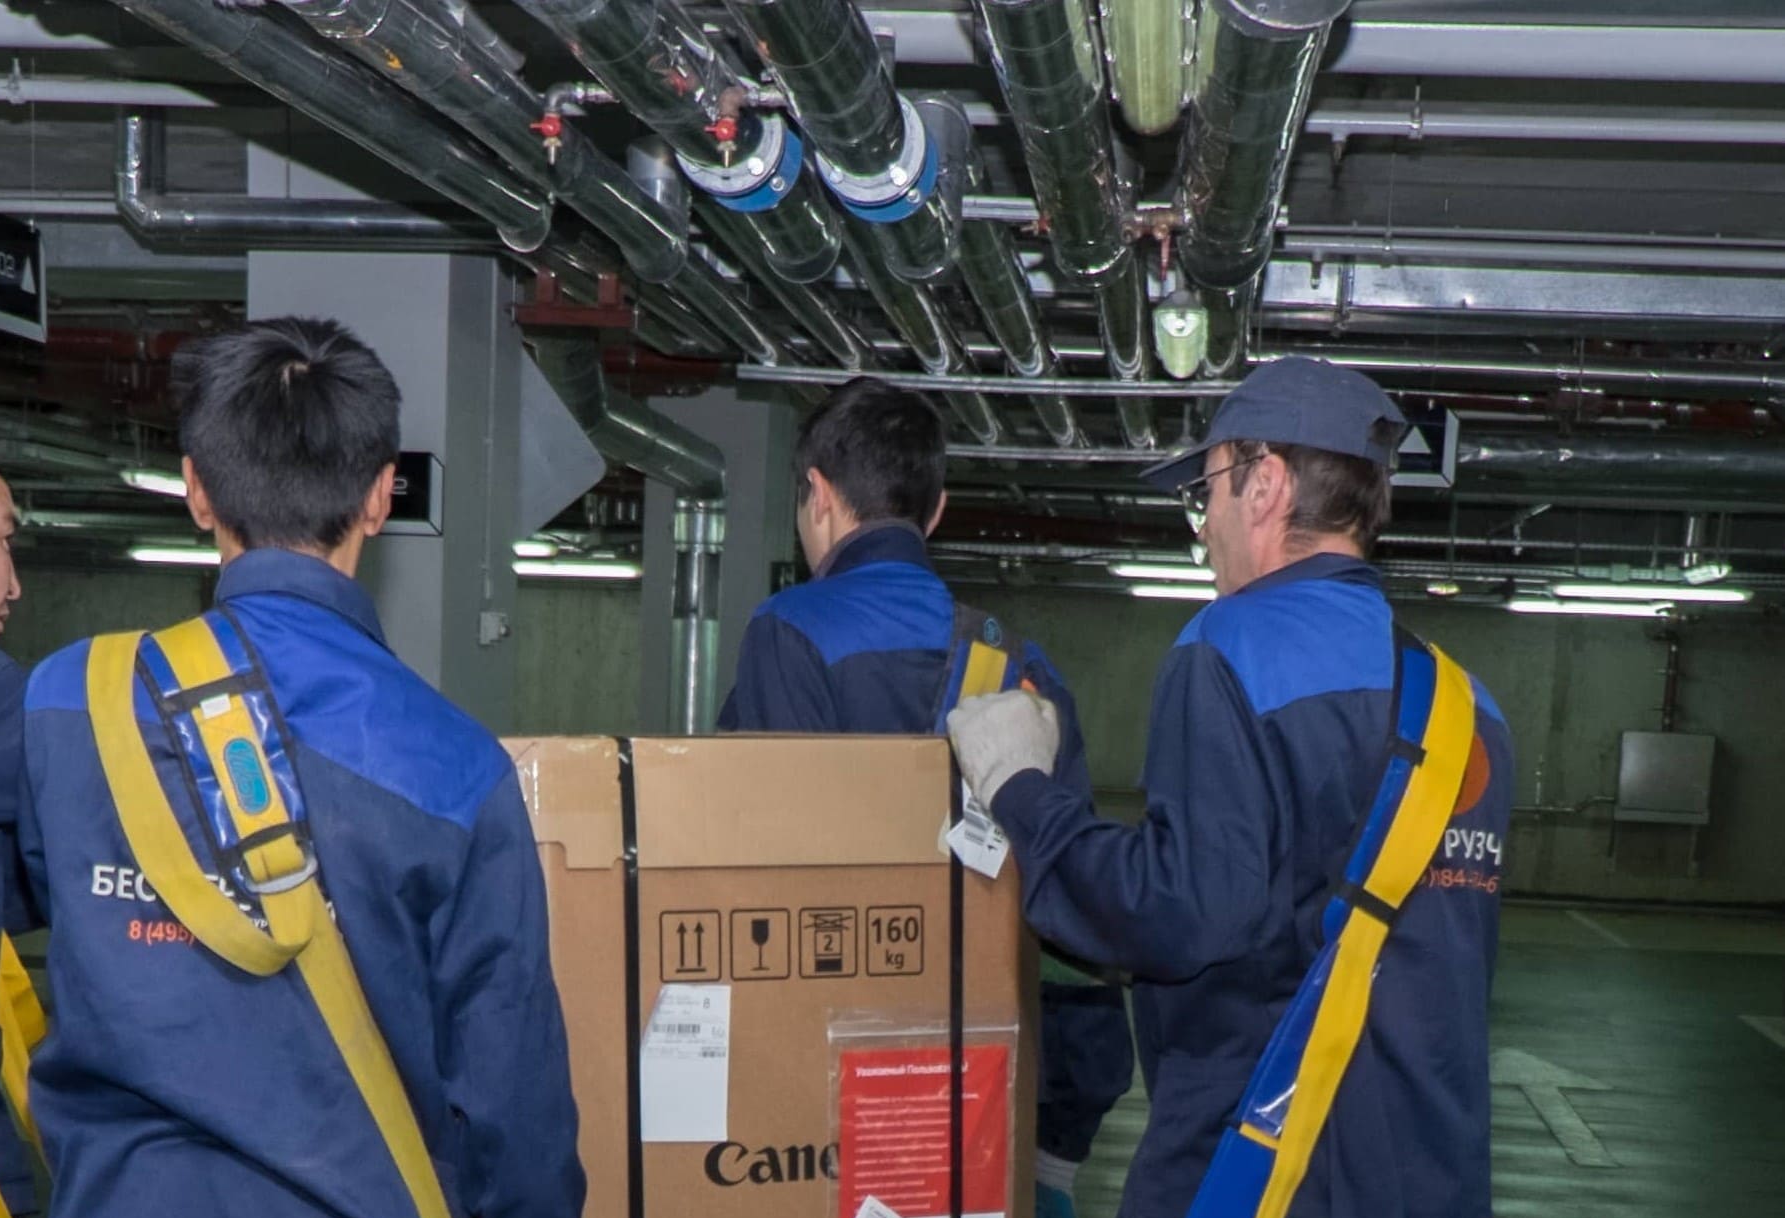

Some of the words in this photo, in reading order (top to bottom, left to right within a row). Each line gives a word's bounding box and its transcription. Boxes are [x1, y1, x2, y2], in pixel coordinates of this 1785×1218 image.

[823, 934, 834, 952] 2
[870, 916, 919, 946] 160
[885, 951, 905, 970] kg
[704, 1141, 840, 1187] Cano
